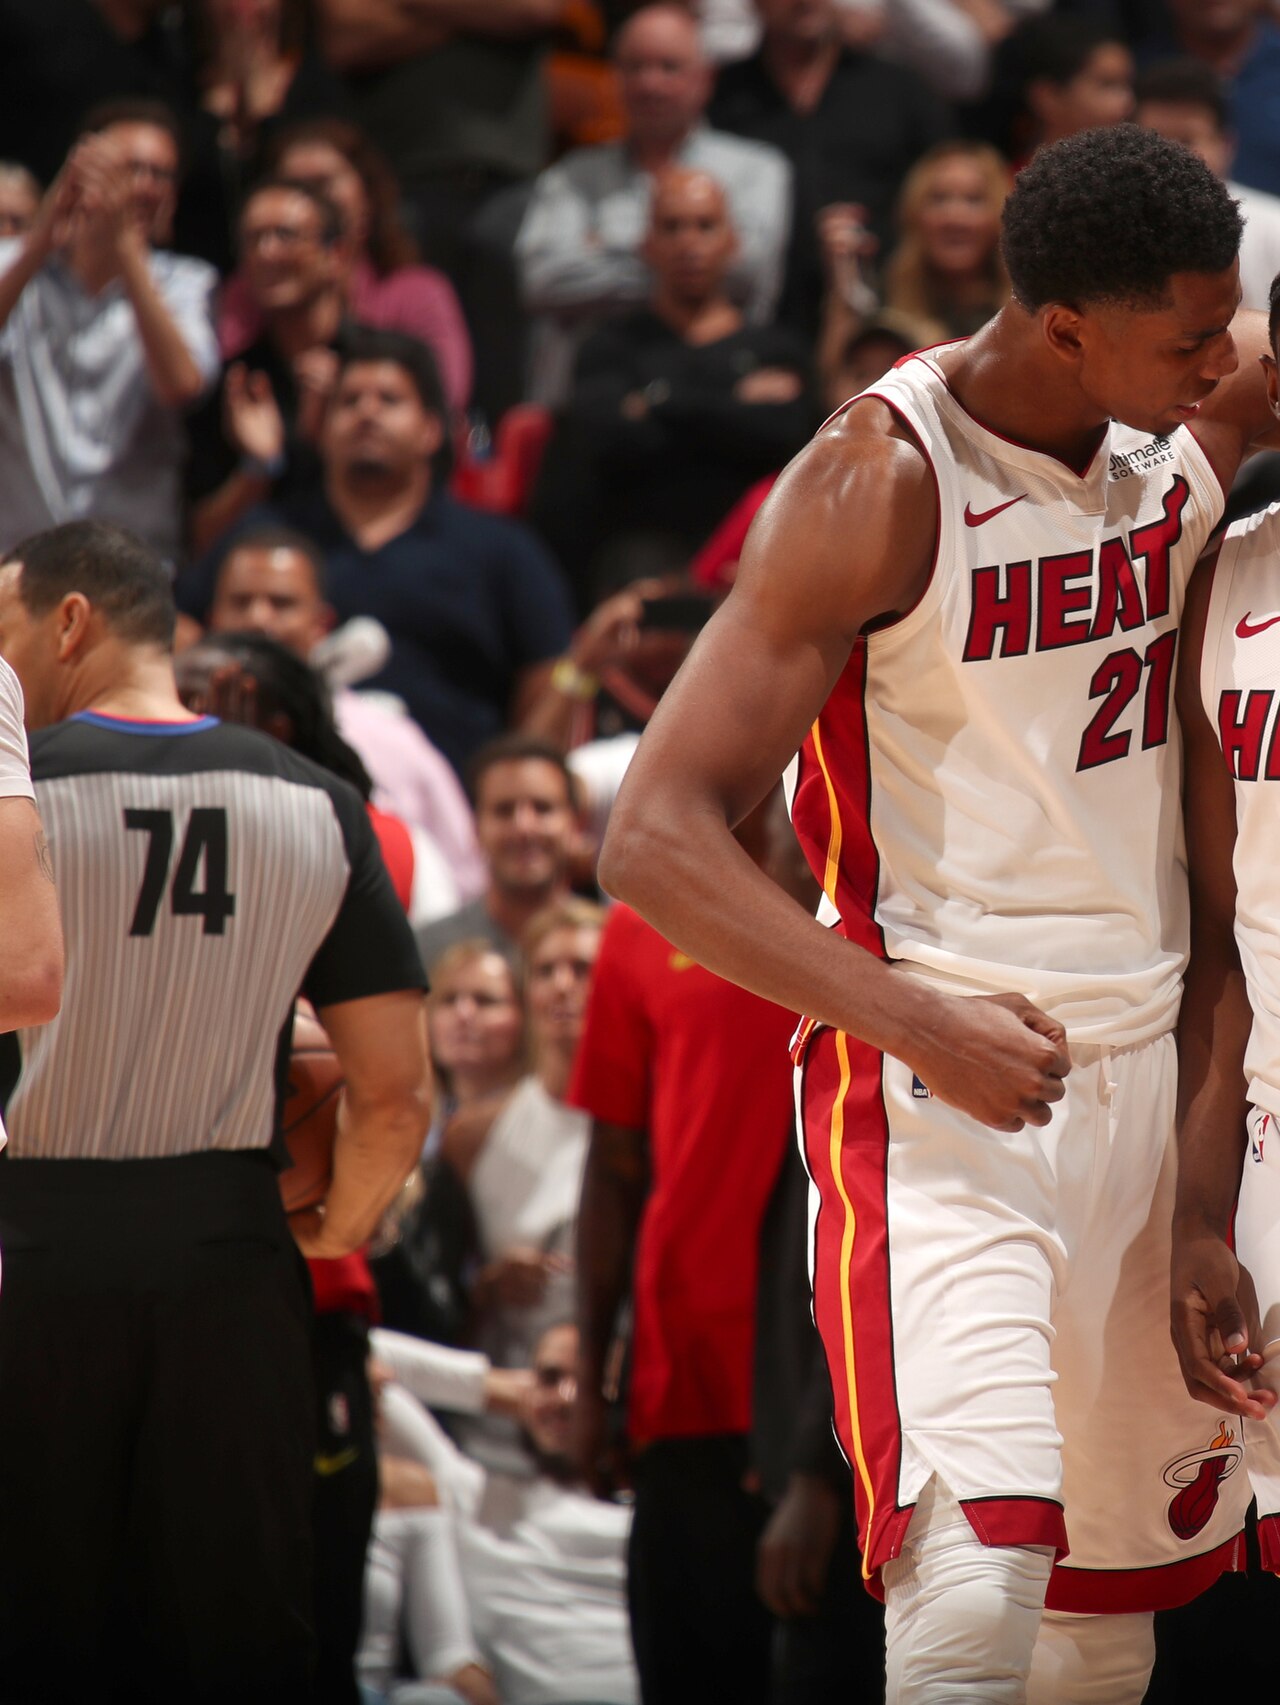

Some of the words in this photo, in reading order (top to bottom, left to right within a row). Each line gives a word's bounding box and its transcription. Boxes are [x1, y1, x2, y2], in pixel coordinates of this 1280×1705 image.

[1112, 451, 1175, 480] SOFTWARE
[962, 473, 1190, 662] HEAT
[1076, 628, 1178, 773] 21
[123, 808, 236, 936] 74
